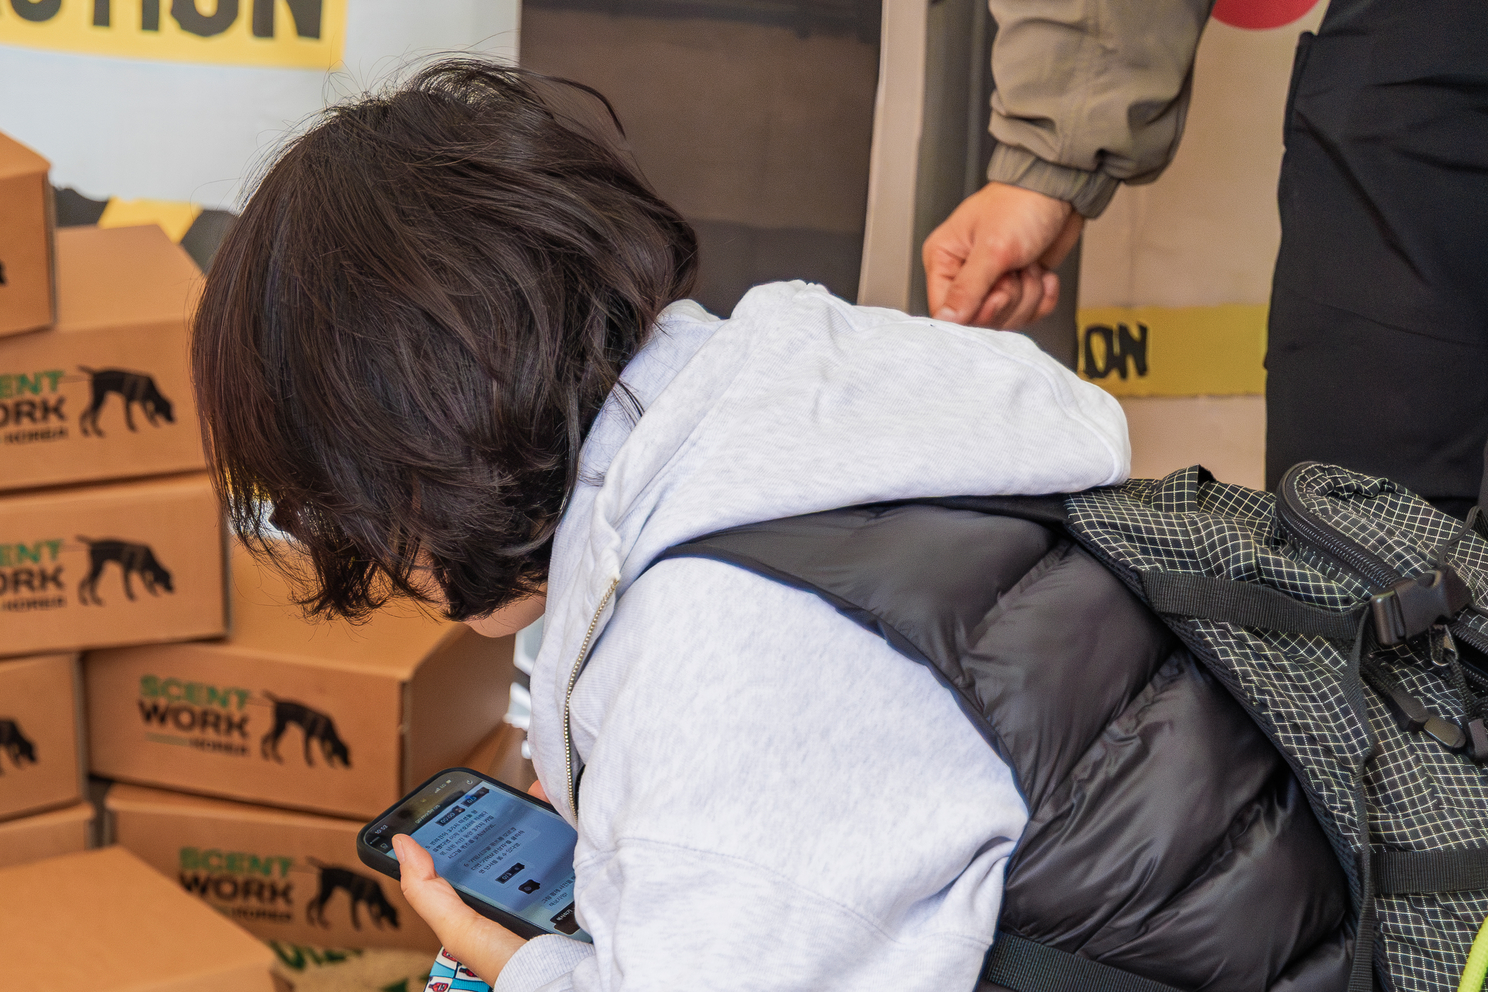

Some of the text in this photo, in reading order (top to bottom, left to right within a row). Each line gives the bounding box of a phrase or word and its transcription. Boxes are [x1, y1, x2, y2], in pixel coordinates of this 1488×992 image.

[139, 674, 250, 711] SCENT
[138, 699, 250, 738] WORK
[179, 872, 292, 904] WORK
